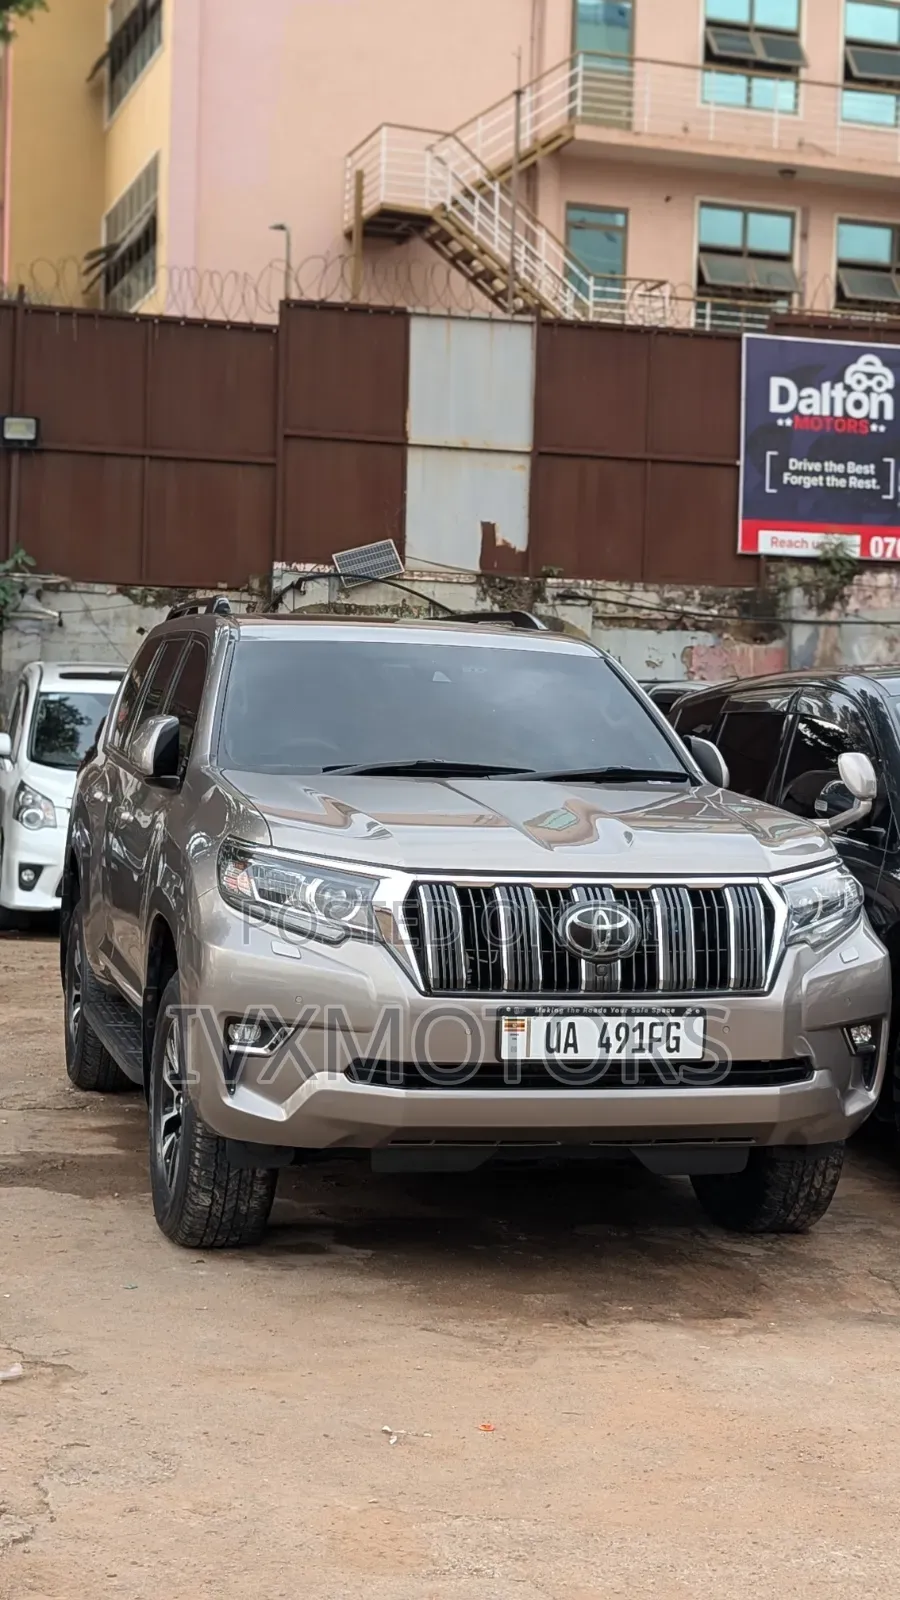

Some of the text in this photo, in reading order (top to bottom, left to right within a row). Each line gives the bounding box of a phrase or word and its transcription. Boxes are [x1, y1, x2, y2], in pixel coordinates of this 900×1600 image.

[768, 376, 895, 421] Dalton
[792, 415, 870, 435] MOTORS
[788, 457, 876, 476] Drive the Best
[782, 472, 881, 490] Forget the Rest.
[769, 536, 809, 549] Reach
[534, 1006, 564, 1015] Making
[566, 1006, 580, 1014] the
[582, 1006, 607, 1014] Roads
[610, 1006, 628, 1014] Your
[630, 1006, 649, 1014] Safe
[651, 1006, 676, 1016] Space
[545, 1021, 579, 1055] UA
